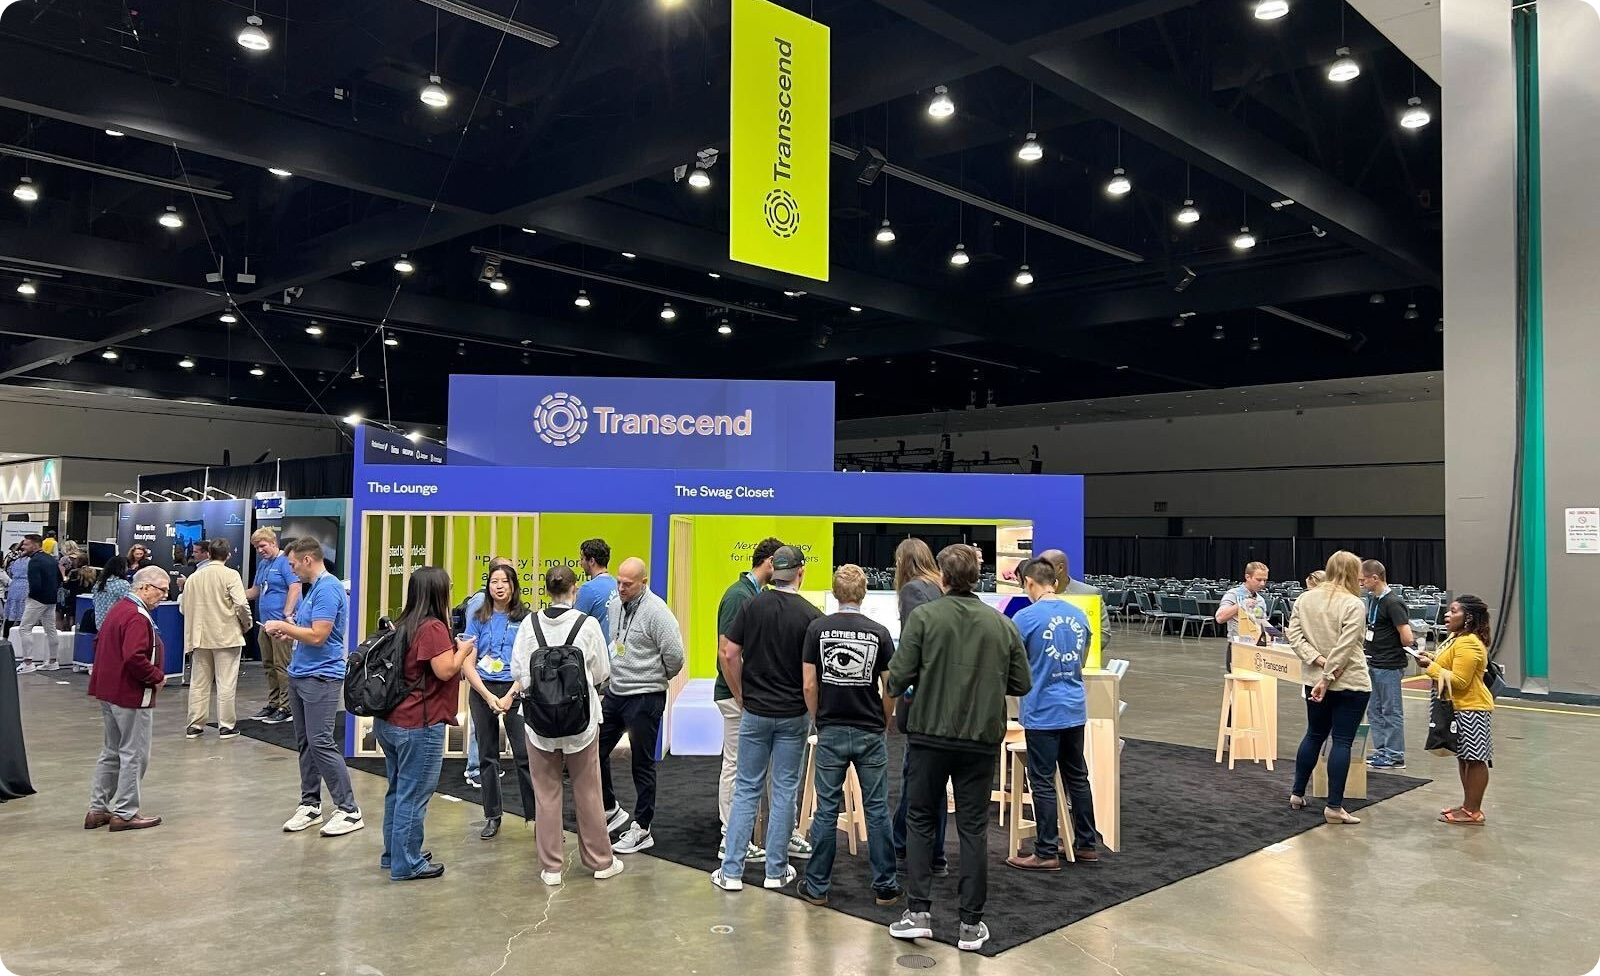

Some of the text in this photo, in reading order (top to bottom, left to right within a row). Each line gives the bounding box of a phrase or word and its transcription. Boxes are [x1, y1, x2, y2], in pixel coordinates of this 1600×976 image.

[774, 36, 792, 182] Transcend
[592, 406, 753, 436] Transcend
[367, 482, 438, 496] The Lounge
[675, 485, 775, 500] The Swag Closet
[544, 559, 560, 567] no
[564, 557, 579, 567] lon
[820, 630, 830, 639] AS
[830, 630, 856, 640] CITIES
[1042, 615, 1084, 662] Data rights for all
[1262, 658, 1288, 674] Transcend
